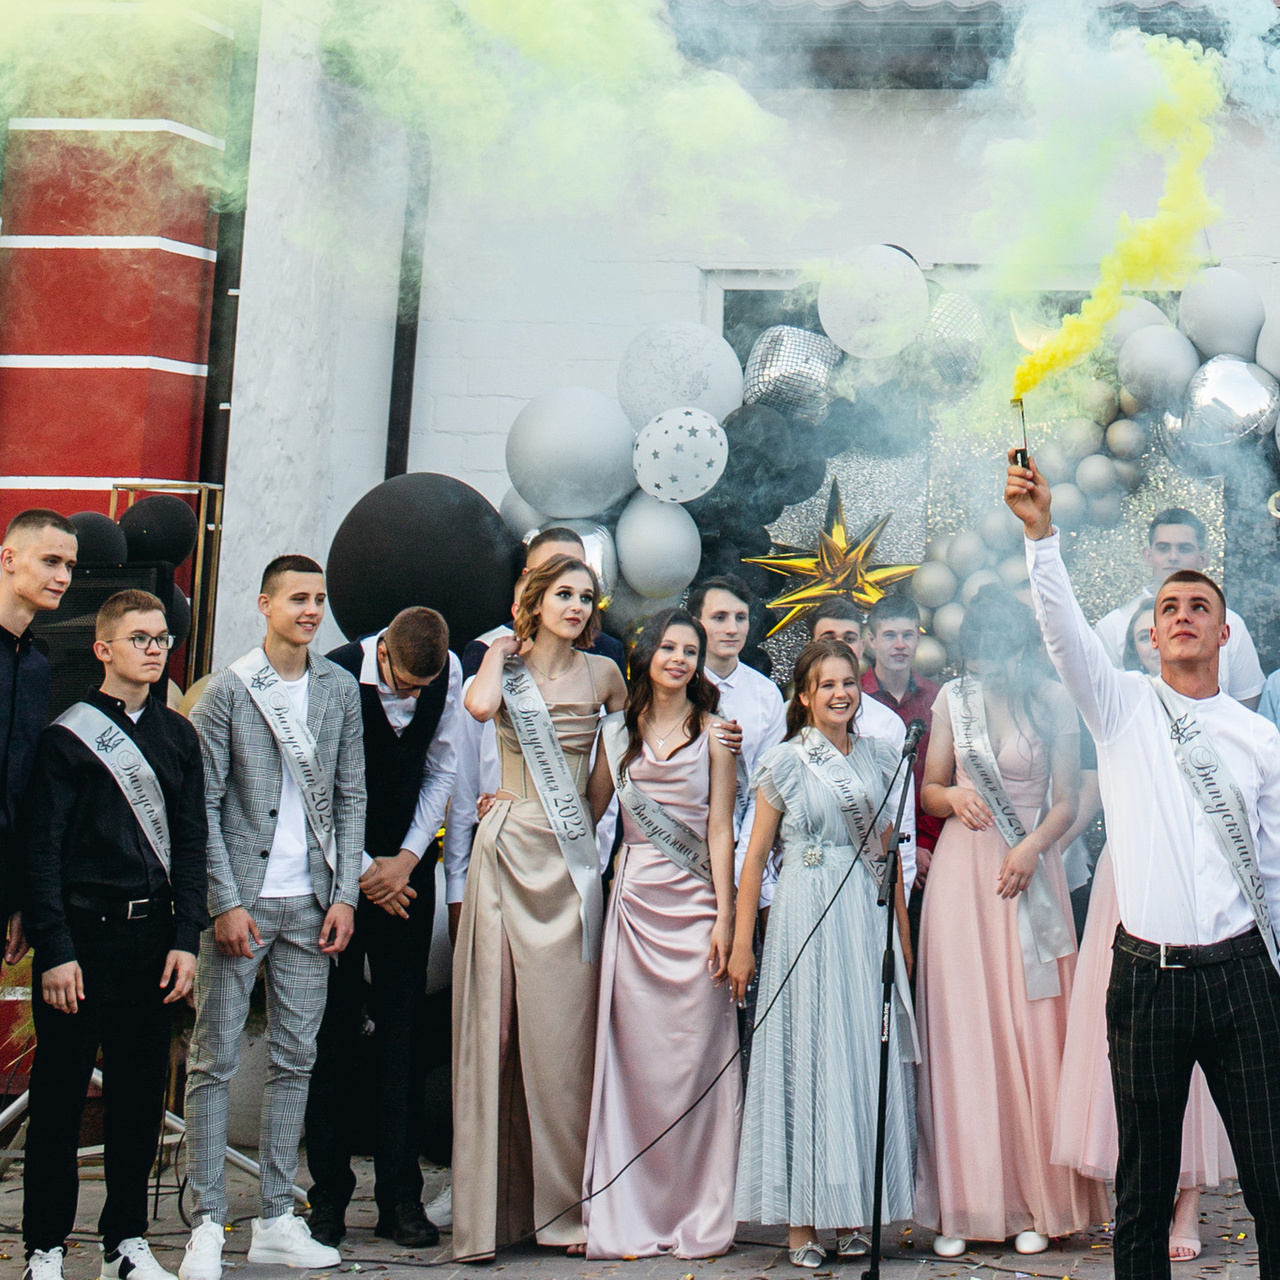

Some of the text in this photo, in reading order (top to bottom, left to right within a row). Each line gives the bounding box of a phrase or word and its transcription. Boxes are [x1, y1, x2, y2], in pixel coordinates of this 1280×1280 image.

[269, 692, 316, 788] Випускник
[517, 697, 559, 792] Випускниця
[553, 793, 586, 840] 2023
[117, 750, 165, 845] Випускник
[625, 791, 700, 864] Випускниця
[1189, 745, 1252, 870] Випускник
